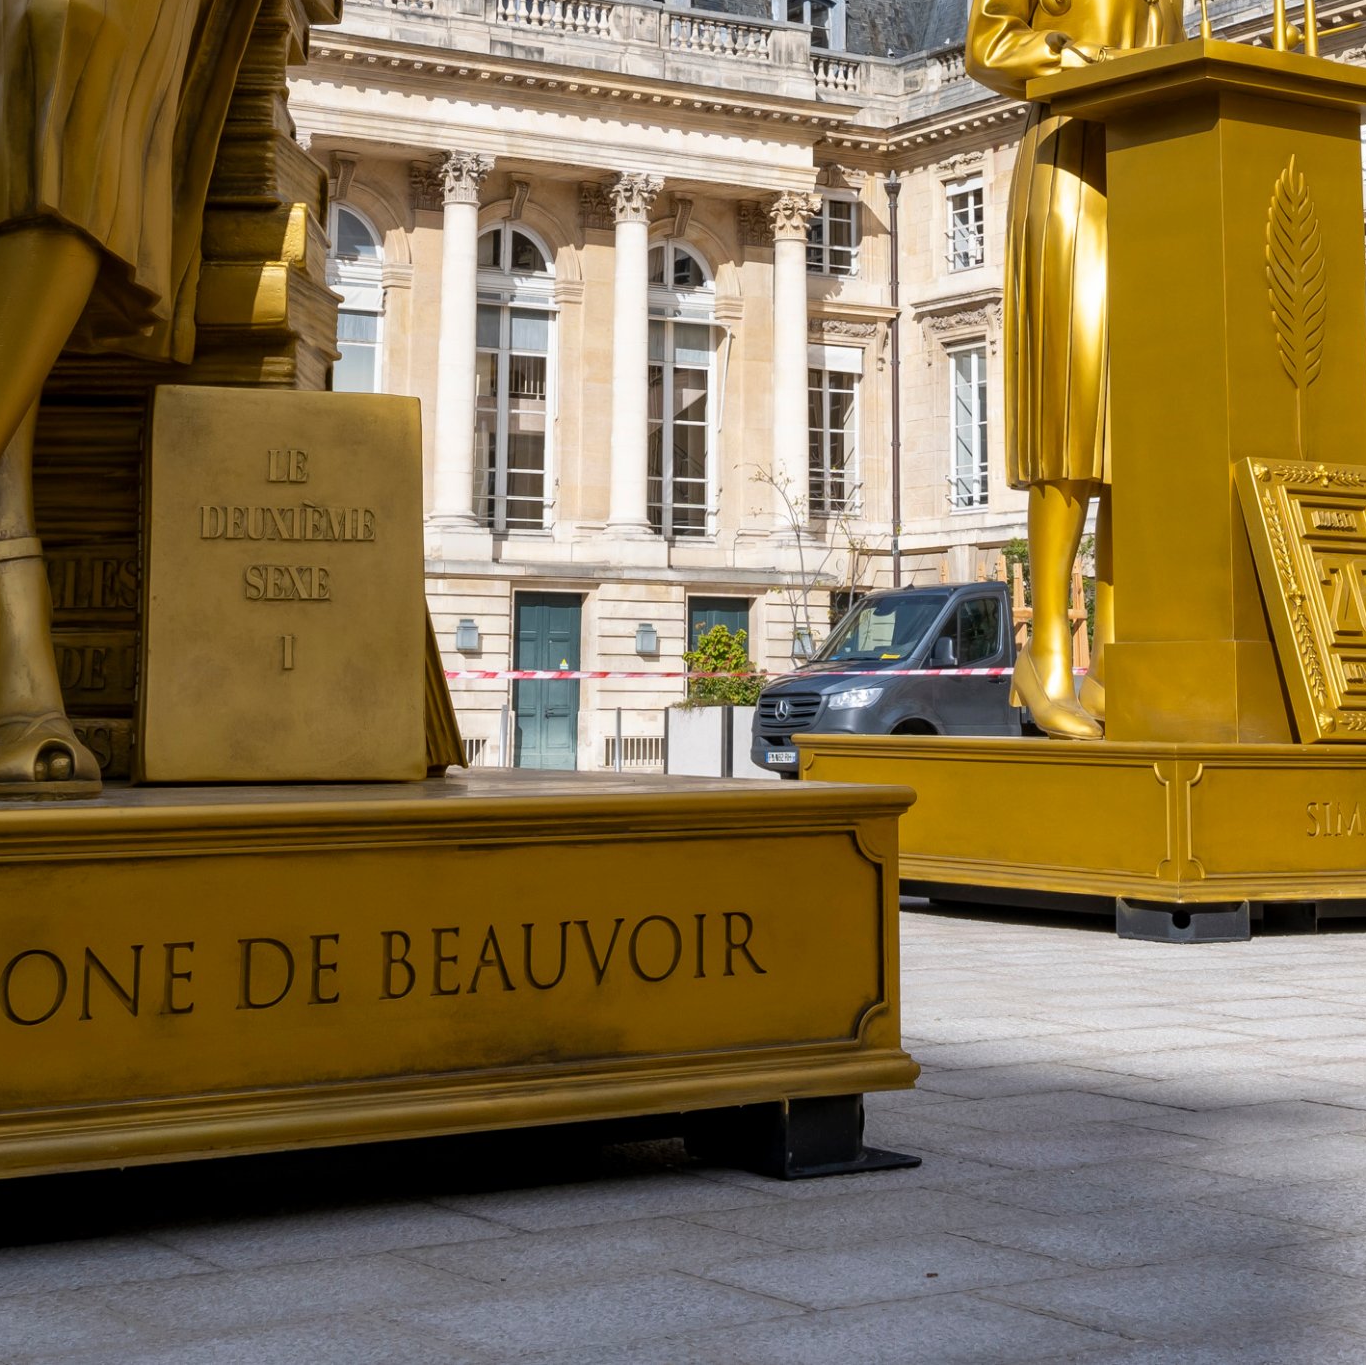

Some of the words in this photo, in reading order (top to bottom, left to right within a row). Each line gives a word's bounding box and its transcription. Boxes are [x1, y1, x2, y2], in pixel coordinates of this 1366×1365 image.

[267, 449, 309, 484] LE
[200, 500, 376, 542] DEUXIÈME
[245, 564, 332, 601] SEXE
[281, 634, 295, 671] I
[235, 933, 341, 1011] DE
[378, 911, 767, 1000] BEAUVOIR
